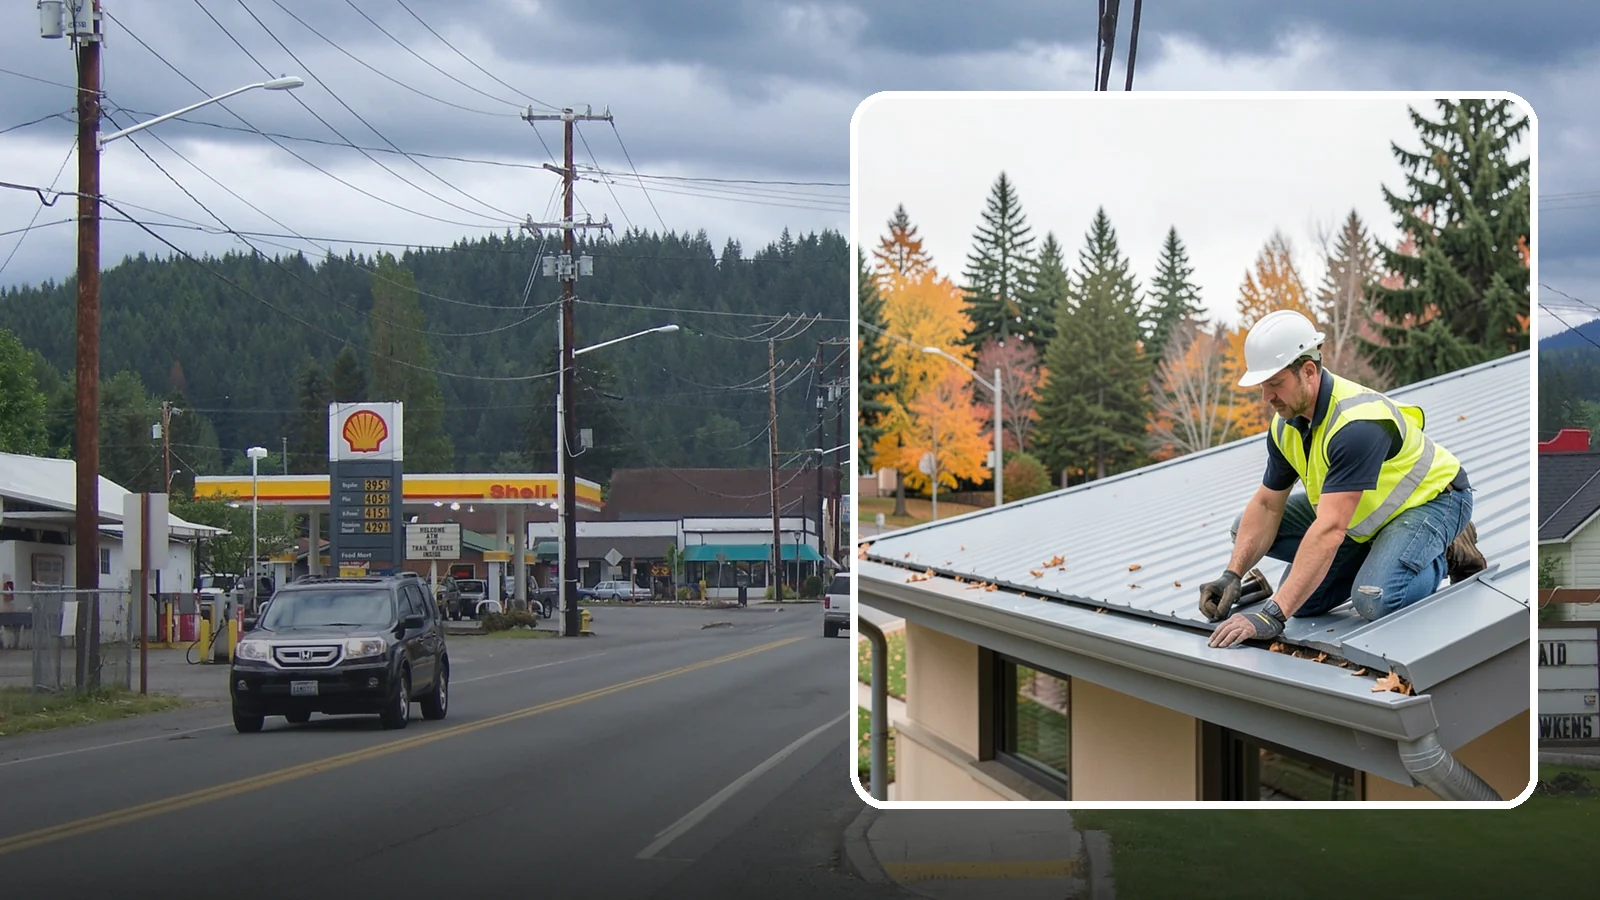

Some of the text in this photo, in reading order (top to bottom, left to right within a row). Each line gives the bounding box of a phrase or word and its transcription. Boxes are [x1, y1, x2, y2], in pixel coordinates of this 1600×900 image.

[342, 481, 358, 489] Regular
[490, 484, 548, 499] Shell
[419, 526, 445, 534] WELCOME
